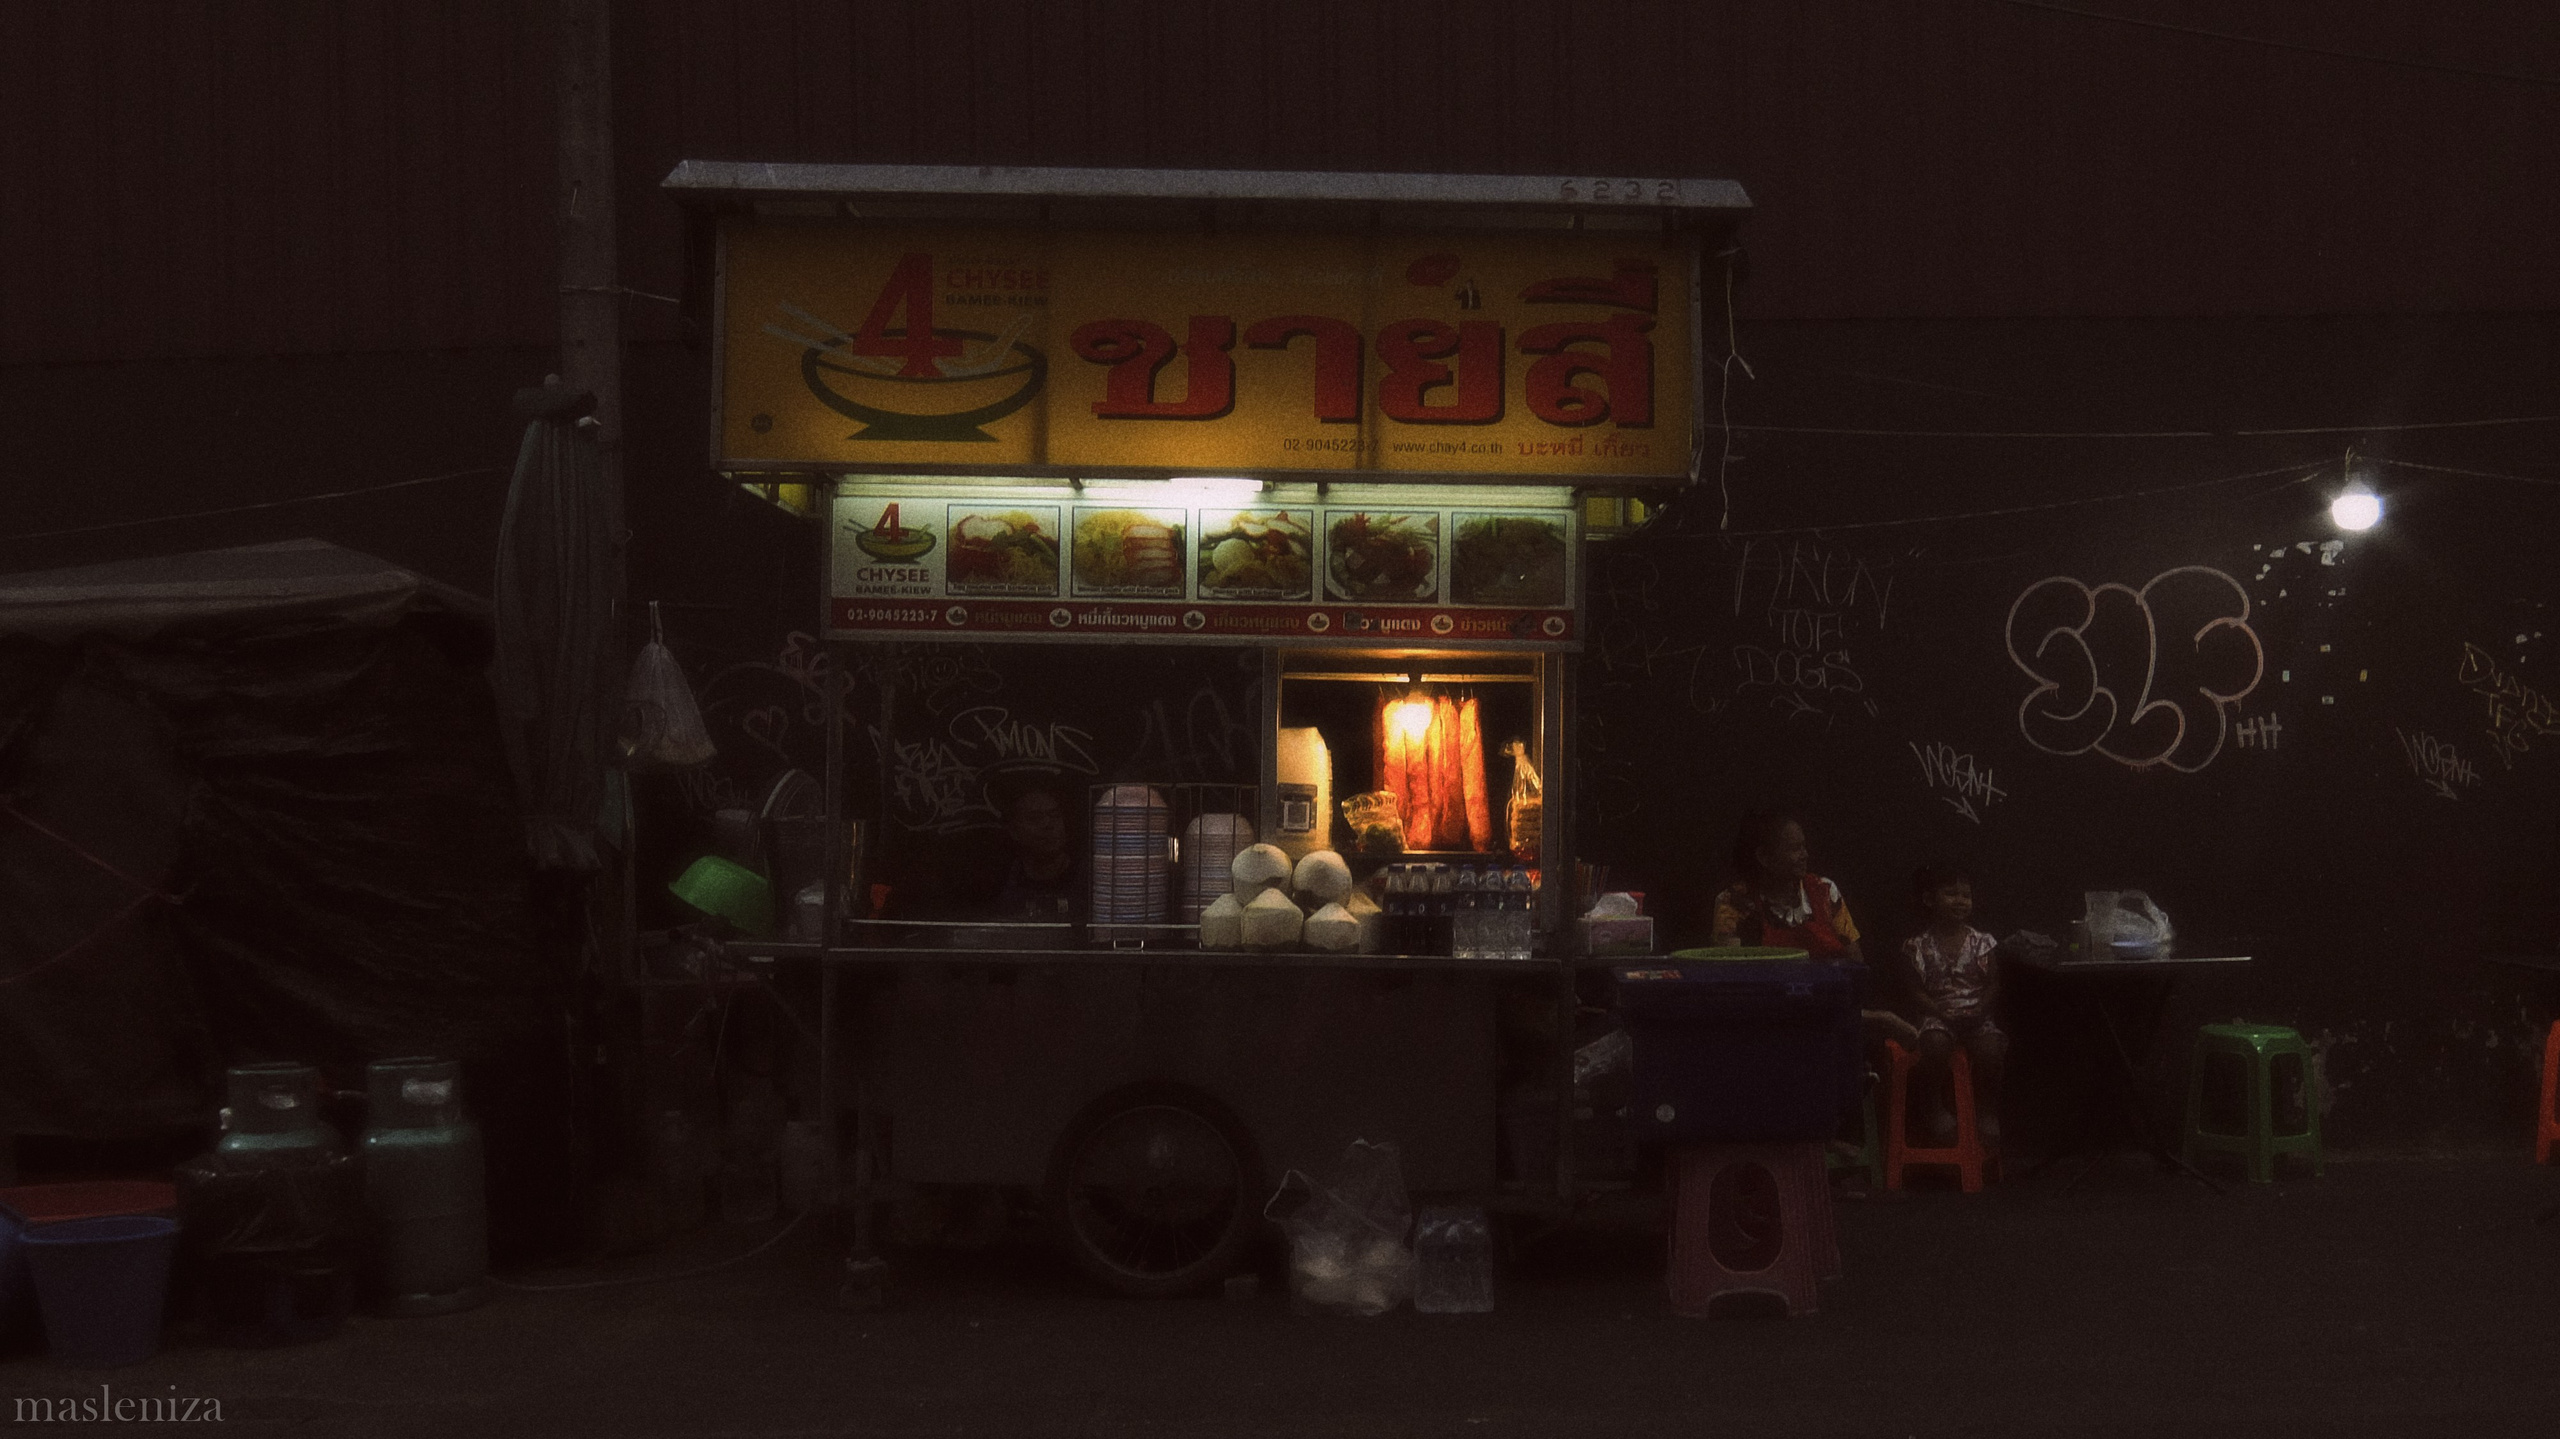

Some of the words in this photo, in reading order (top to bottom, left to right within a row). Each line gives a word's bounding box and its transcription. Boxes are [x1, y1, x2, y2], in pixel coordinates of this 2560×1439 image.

[946, 268, 1050, 290] CHYSEE
[852, 251, 964, 379] 4
[1393, 440, 1503, 456] www.chay4.co.th
[873, 502, 910, 545] 4
[856, 567, 930, 582] CHYSEE
